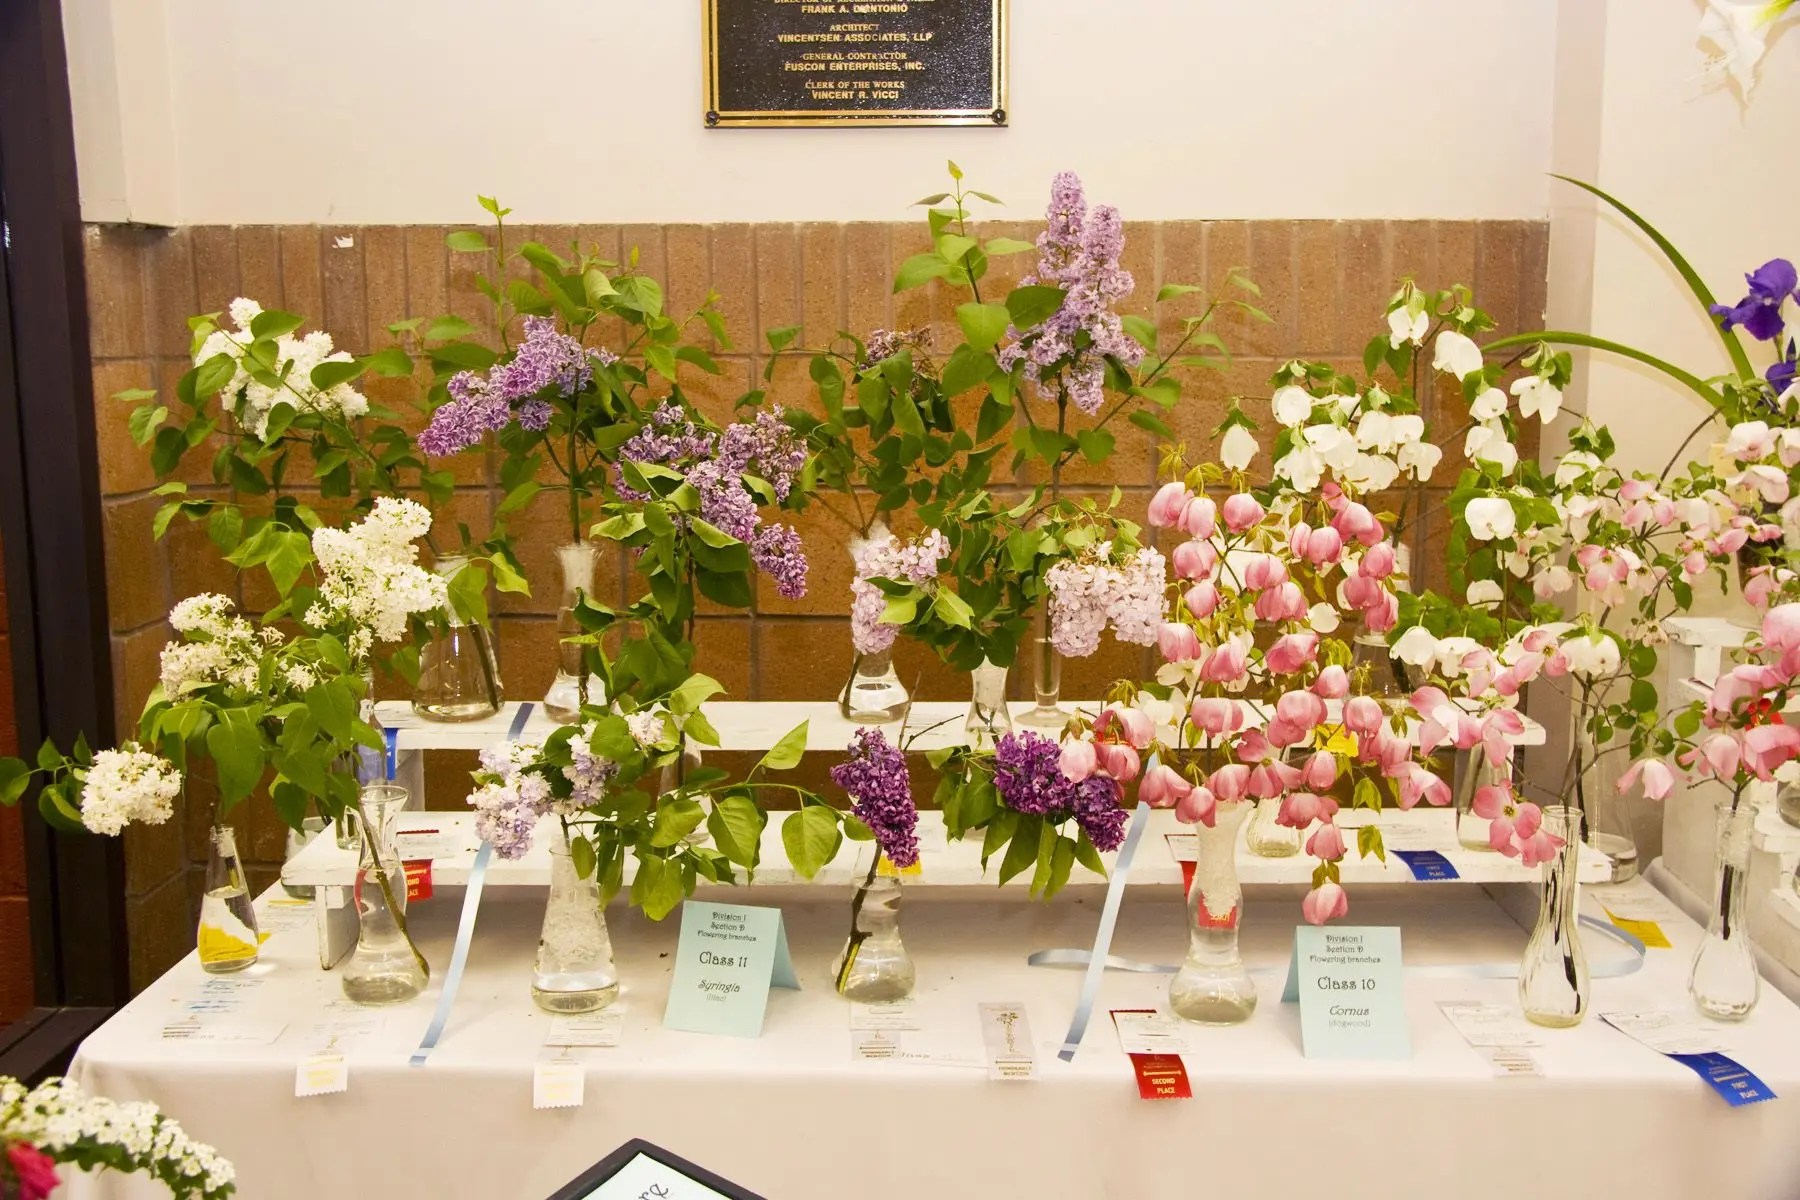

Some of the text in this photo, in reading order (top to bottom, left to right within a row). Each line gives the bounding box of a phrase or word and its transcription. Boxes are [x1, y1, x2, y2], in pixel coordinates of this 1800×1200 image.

[801, 4, 835, 14] FRANK
[839, 4, 850, 14] A.
[829, 23, 880, 32] ARCHITECT
[777, 32, 933, 43] VINCENTSEN ASSOCIATES, LLP
[802, 51, 907, 61] GENERAL CONTRACTOR
[784, 62, 926, 72] FUSCON ENTERPRISES, INC.
[805, 81, 905, 89] CLERK OF THE WORKS
[811, 90, 899, 100] VINCENT R. VICCI
[699, 951, 734, 967] Class
[1317, 976, 1376, 990] Class 10
[1329, 1005, 1370, 1016] Cornus
[1151, 1077, 1176, 1085] SECOND
[1156, 1086, 1176, 1095] PLACE
